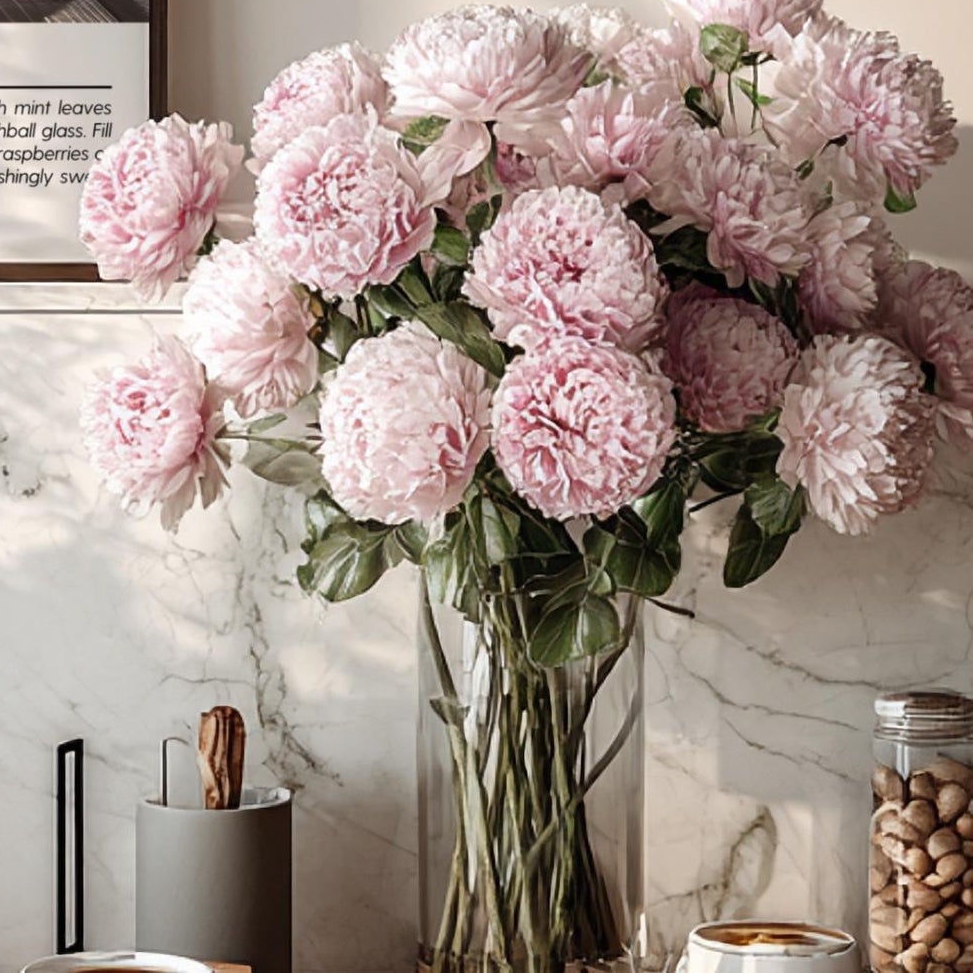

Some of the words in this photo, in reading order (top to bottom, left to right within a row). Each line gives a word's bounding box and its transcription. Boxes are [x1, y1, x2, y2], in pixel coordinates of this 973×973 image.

[14, 100, 51, 115] mint
[58, 100, 111, 115] leaves
[42, 123, 86, 141] glass.
[92, 122, 113, 138] Fill
